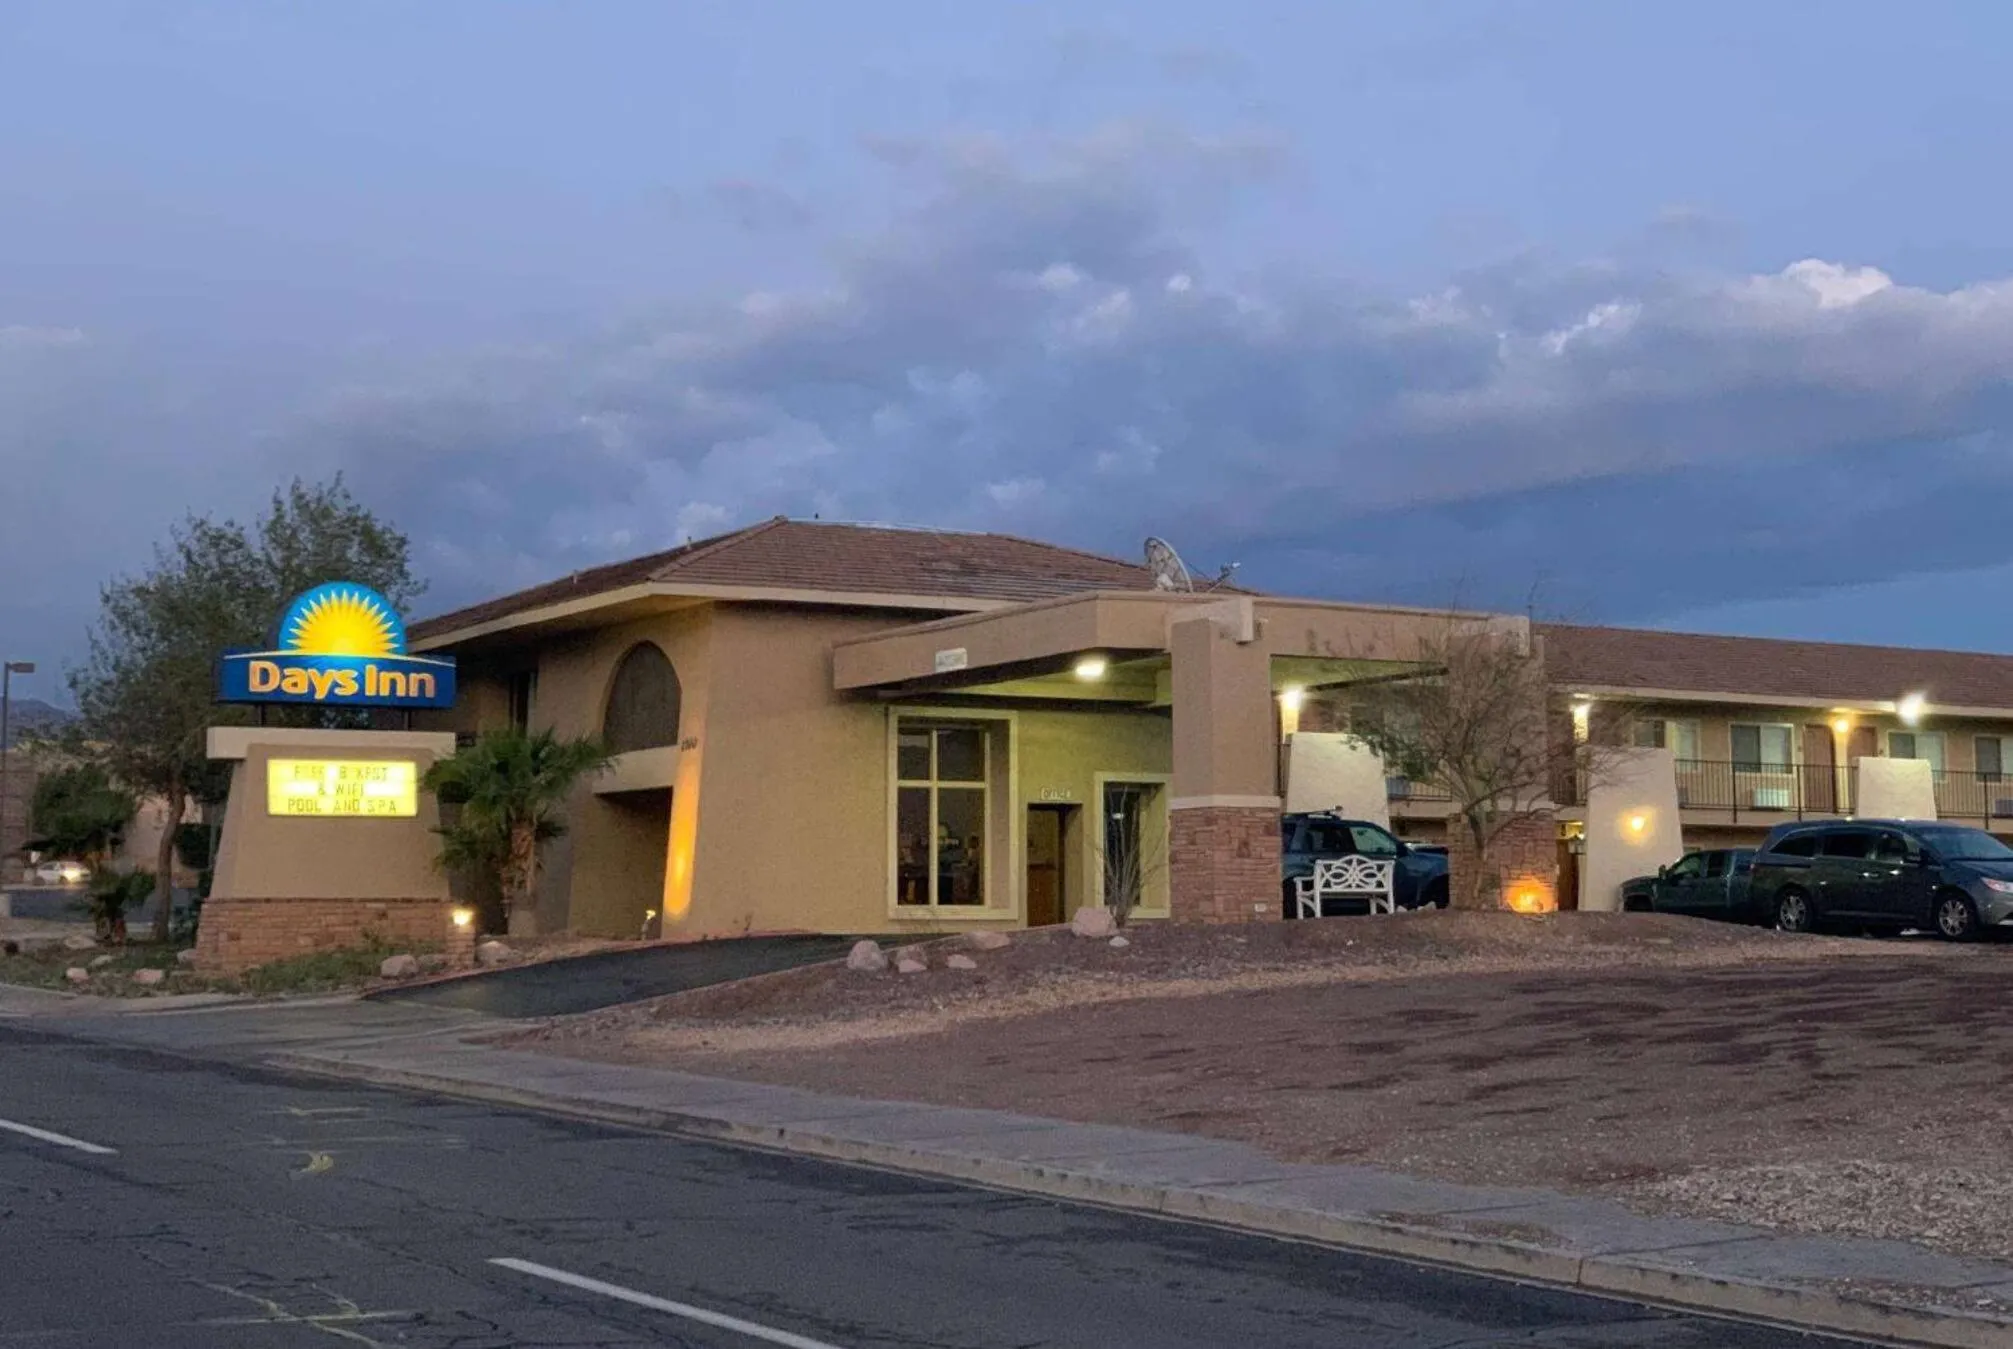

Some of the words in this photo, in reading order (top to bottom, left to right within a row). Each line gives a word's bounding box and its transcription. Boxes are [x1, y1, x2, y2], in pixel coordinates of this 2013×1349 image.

[248, 660, 358, 700] Days
[365, 664, 436, 698] Inn
[287, 798, 322, 813] POOL
[333, 799, 360, 813] AND
[367, 799, 397, 813] SPA
